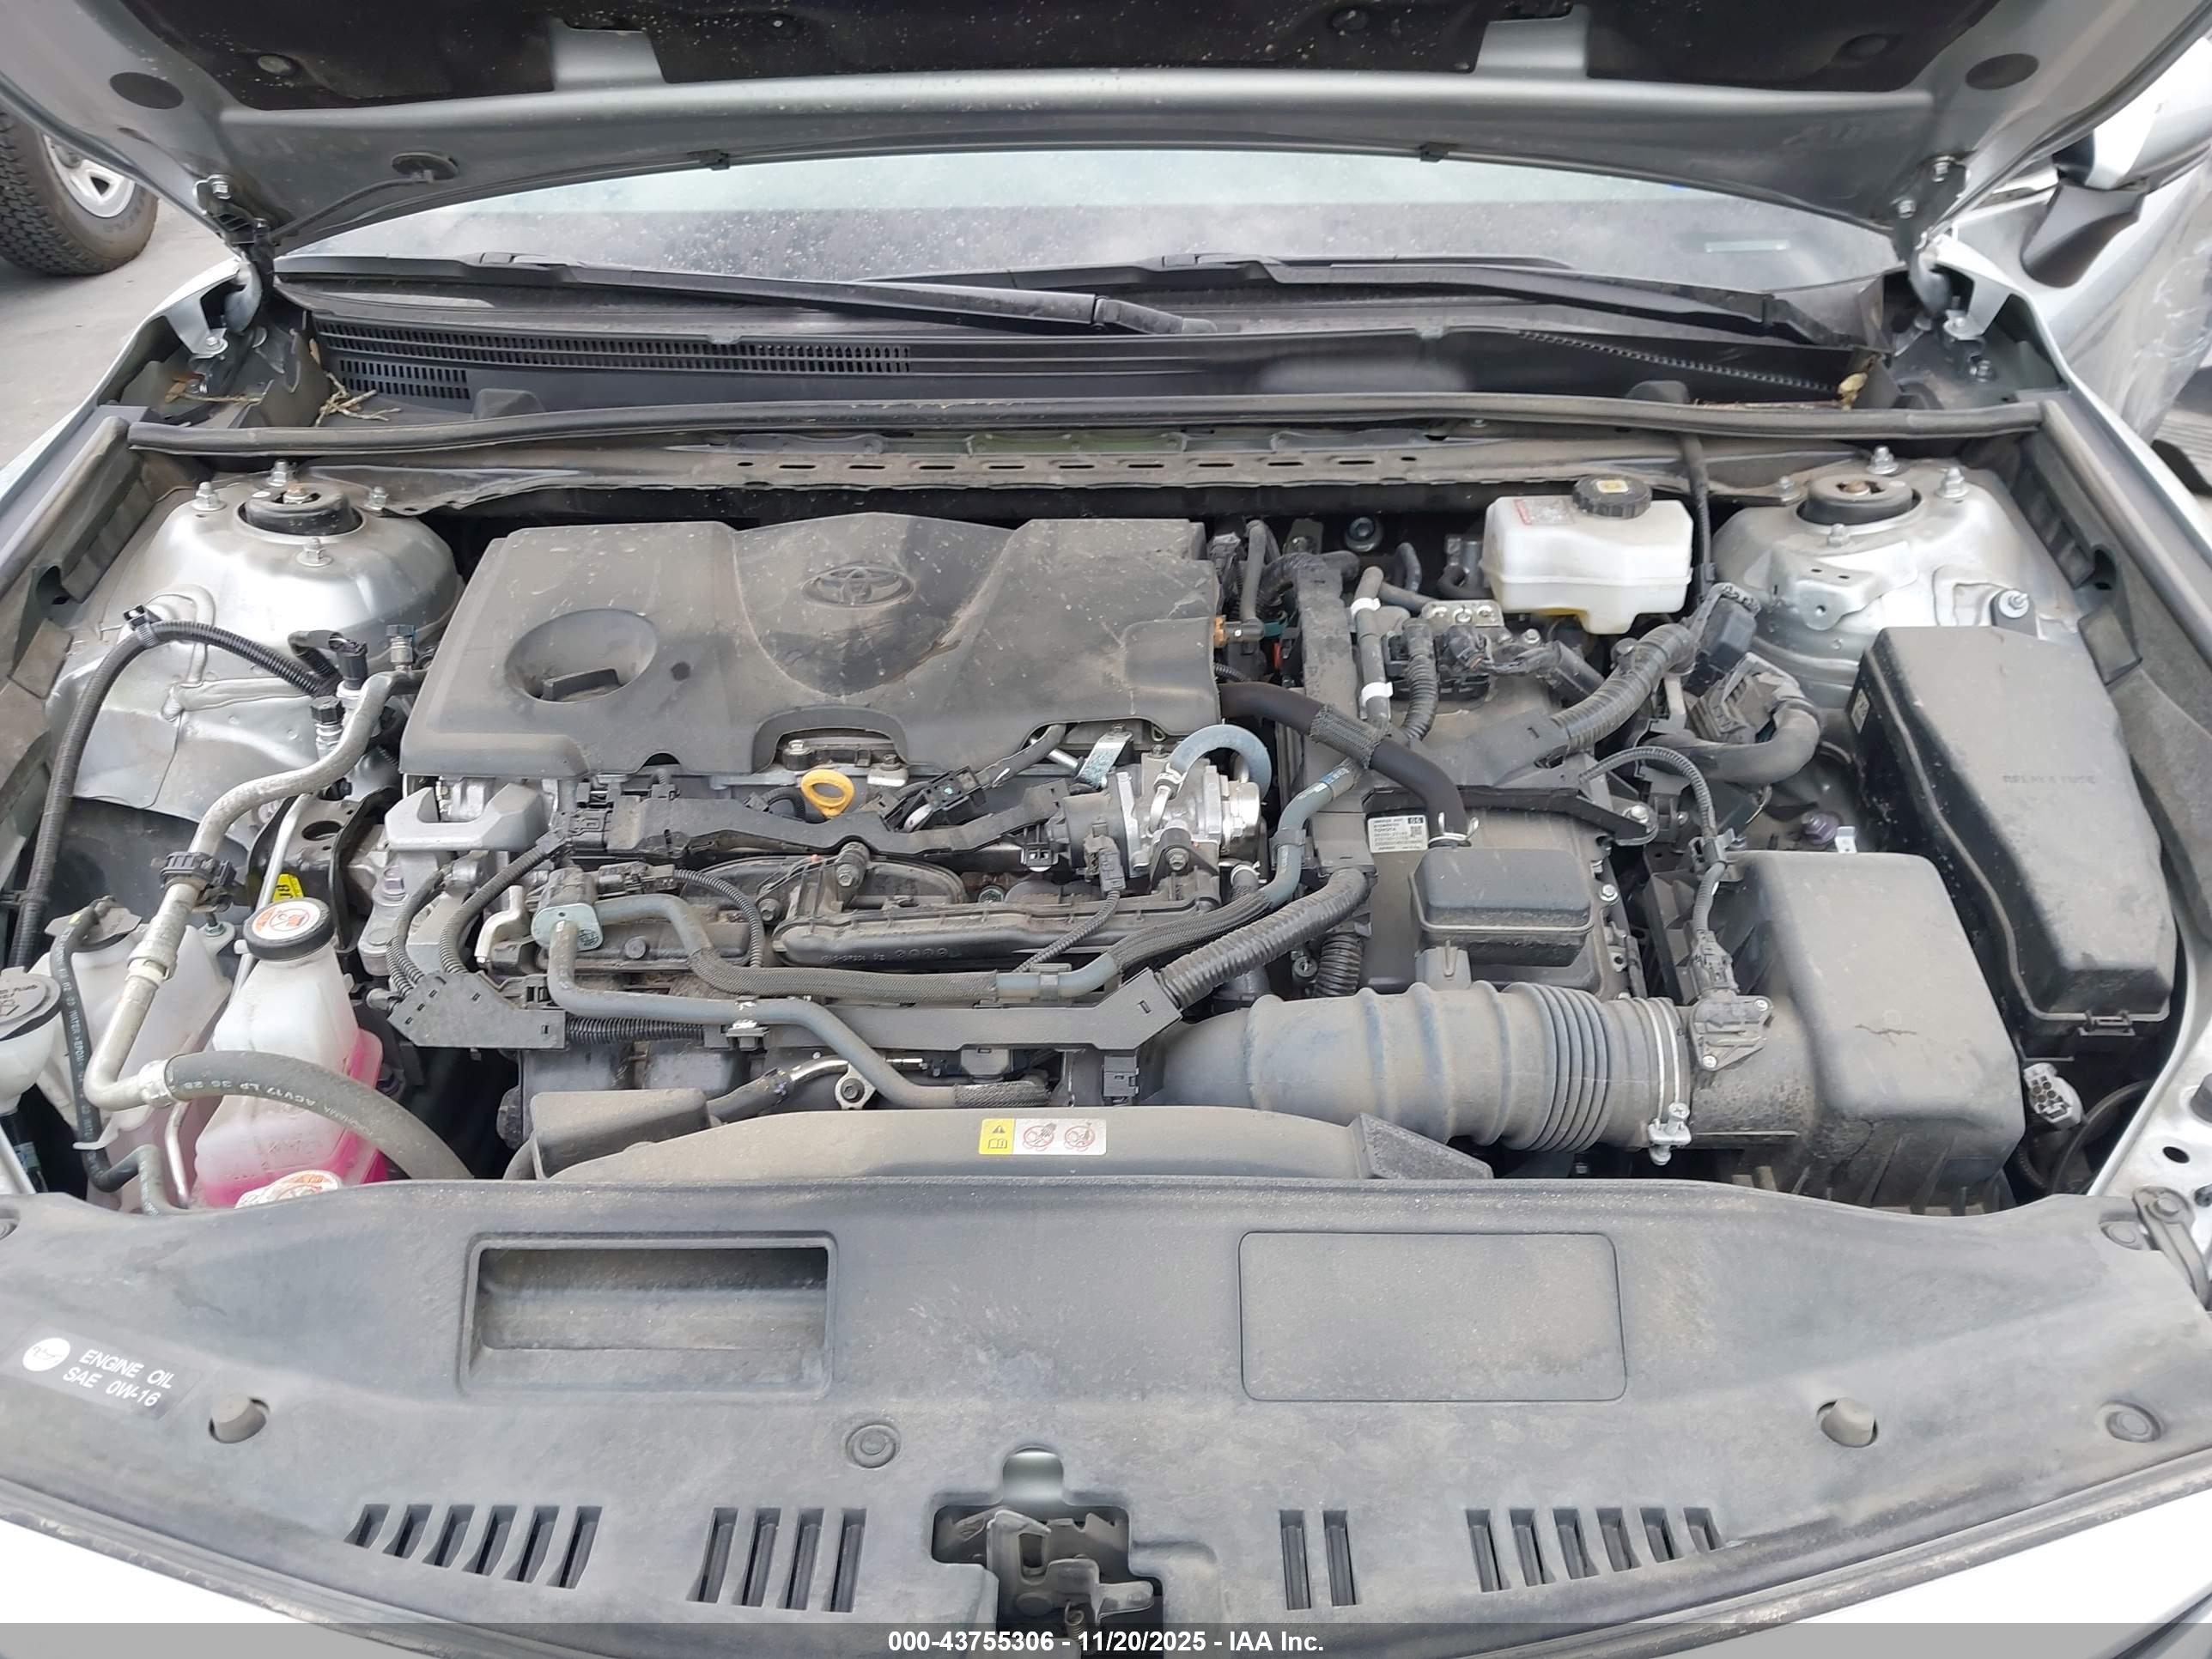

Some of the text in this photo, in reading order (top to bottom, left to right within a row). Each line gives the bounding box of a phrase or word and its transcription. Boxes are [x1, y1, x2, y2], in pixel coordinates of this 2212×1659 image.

[266, 1086, 317, 1107] ACV17
[63, 1367, 161, 1407] SAE 0W-16
[79, 1349, 175, 1389] ENGINE OIL
